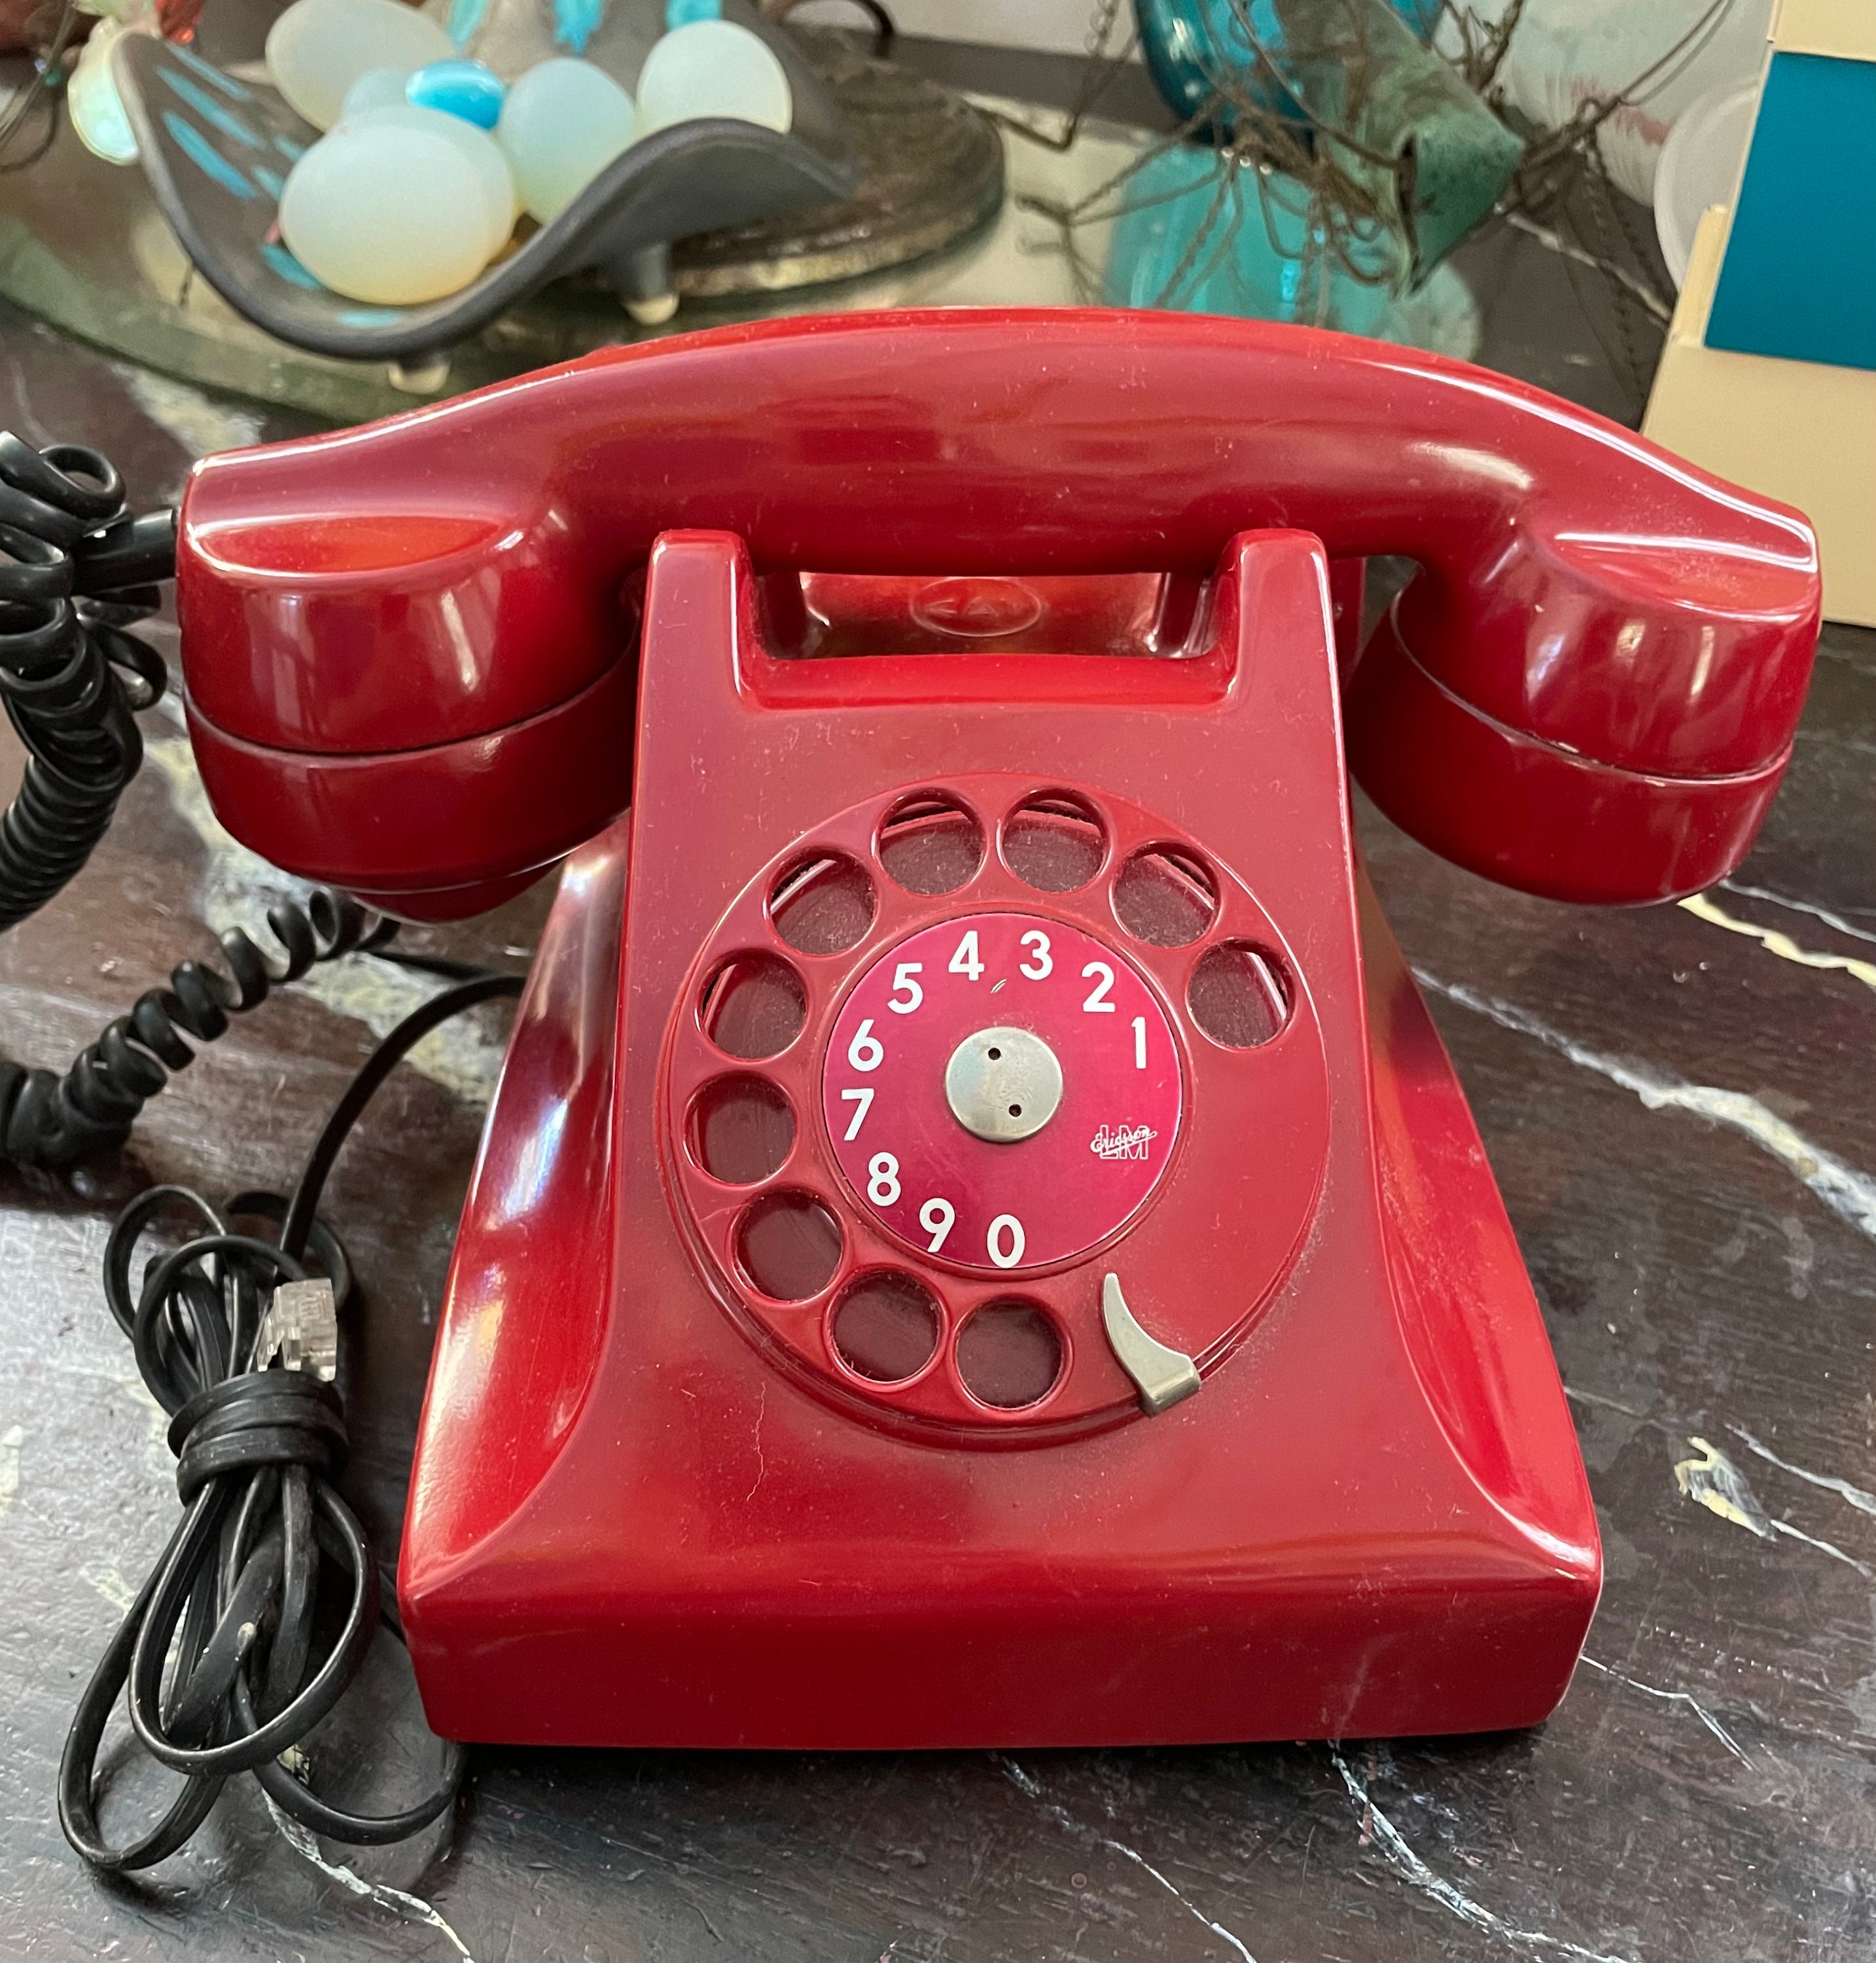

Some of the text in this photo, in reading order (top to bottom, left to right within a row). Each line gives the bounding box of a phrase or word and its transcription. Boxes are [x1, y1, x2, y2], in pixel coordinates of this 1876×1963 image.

[948, 930, 985, 981] 4
[1019, 930, 1053, 980] 3
[887, 963, 923, 1014] 5
[1081, 961, 1116, 1013] 2
[847, 1019, 884, 1072] 6
[1131, 1016, 1146, 1069] 1
[841, 1088, 874, 1141] 7
[866, 1152, 902, 1207] 8
[919, 1197, 955, 1253] 9
[987, 1214, 1026, 1269] 0
